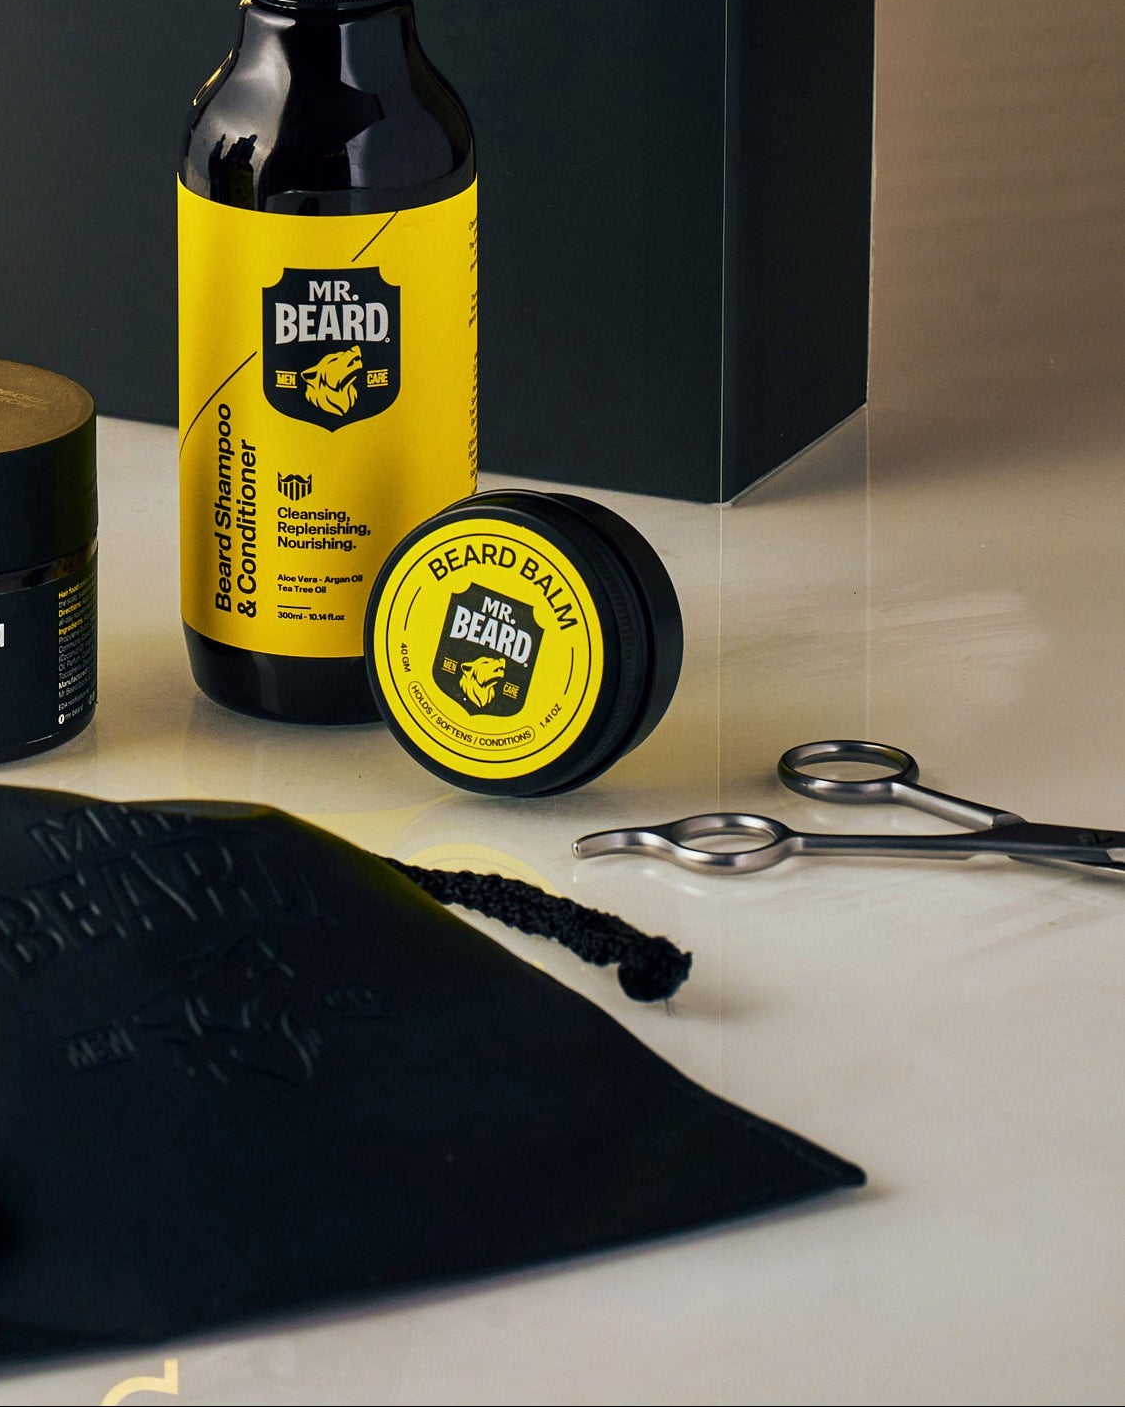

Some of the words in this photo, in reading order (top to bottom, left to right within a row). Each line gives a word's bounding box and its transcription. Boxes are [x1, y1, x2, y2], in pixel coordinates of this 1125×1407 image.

[308, 280, 360, 302] MR.
[277, 373, 296, 385] MEN
[367, 372, 388, 384] CARE
[214, 403, 235, 530] Shampoo
[236, 439, 257, 595] Conditioner
[277, 506, 350, 523] Cleansing,
[277, 521, 371, 536] Replenishing,
[277, 536, 357, 552] Nourishing.
[214, 531, 232, 613] Beard
[277, 574, 296, 582] Aloe
[297, 575, 318, 583] Vera
[324, 576, 350, 584] Argan
[351, 574, 363, 582] Oil
[277, 584, 293, 592] Tea
[294, 585, 313, 593] Tree
[315, 586, 327, 594] Oil
[428, 543, 517, 582] BEARD
[519, 556, 578, 631] BALM
[237, 600, 257, 619] &
[277, 611, 303, 620] 300ml
[327, 613, 345, 621] fl.oz
[481, 595, 516, 625] MR.
[449, 604, 533, 665] BEARD
[400, 642, 408, 655] 40
[402, 657, 412, 673] GM
[443, 659, 458, 672] MEN
[503, 682, 520, 696] CARE
[411, 685, 434, 715] HOLDS
[435, 716, 473, 743] SOFTENS
[479, 730, 532, 747] CONDITIONS
[539, 713, 554, 729] 1.41
[551, 703, 562, 717] OZ
